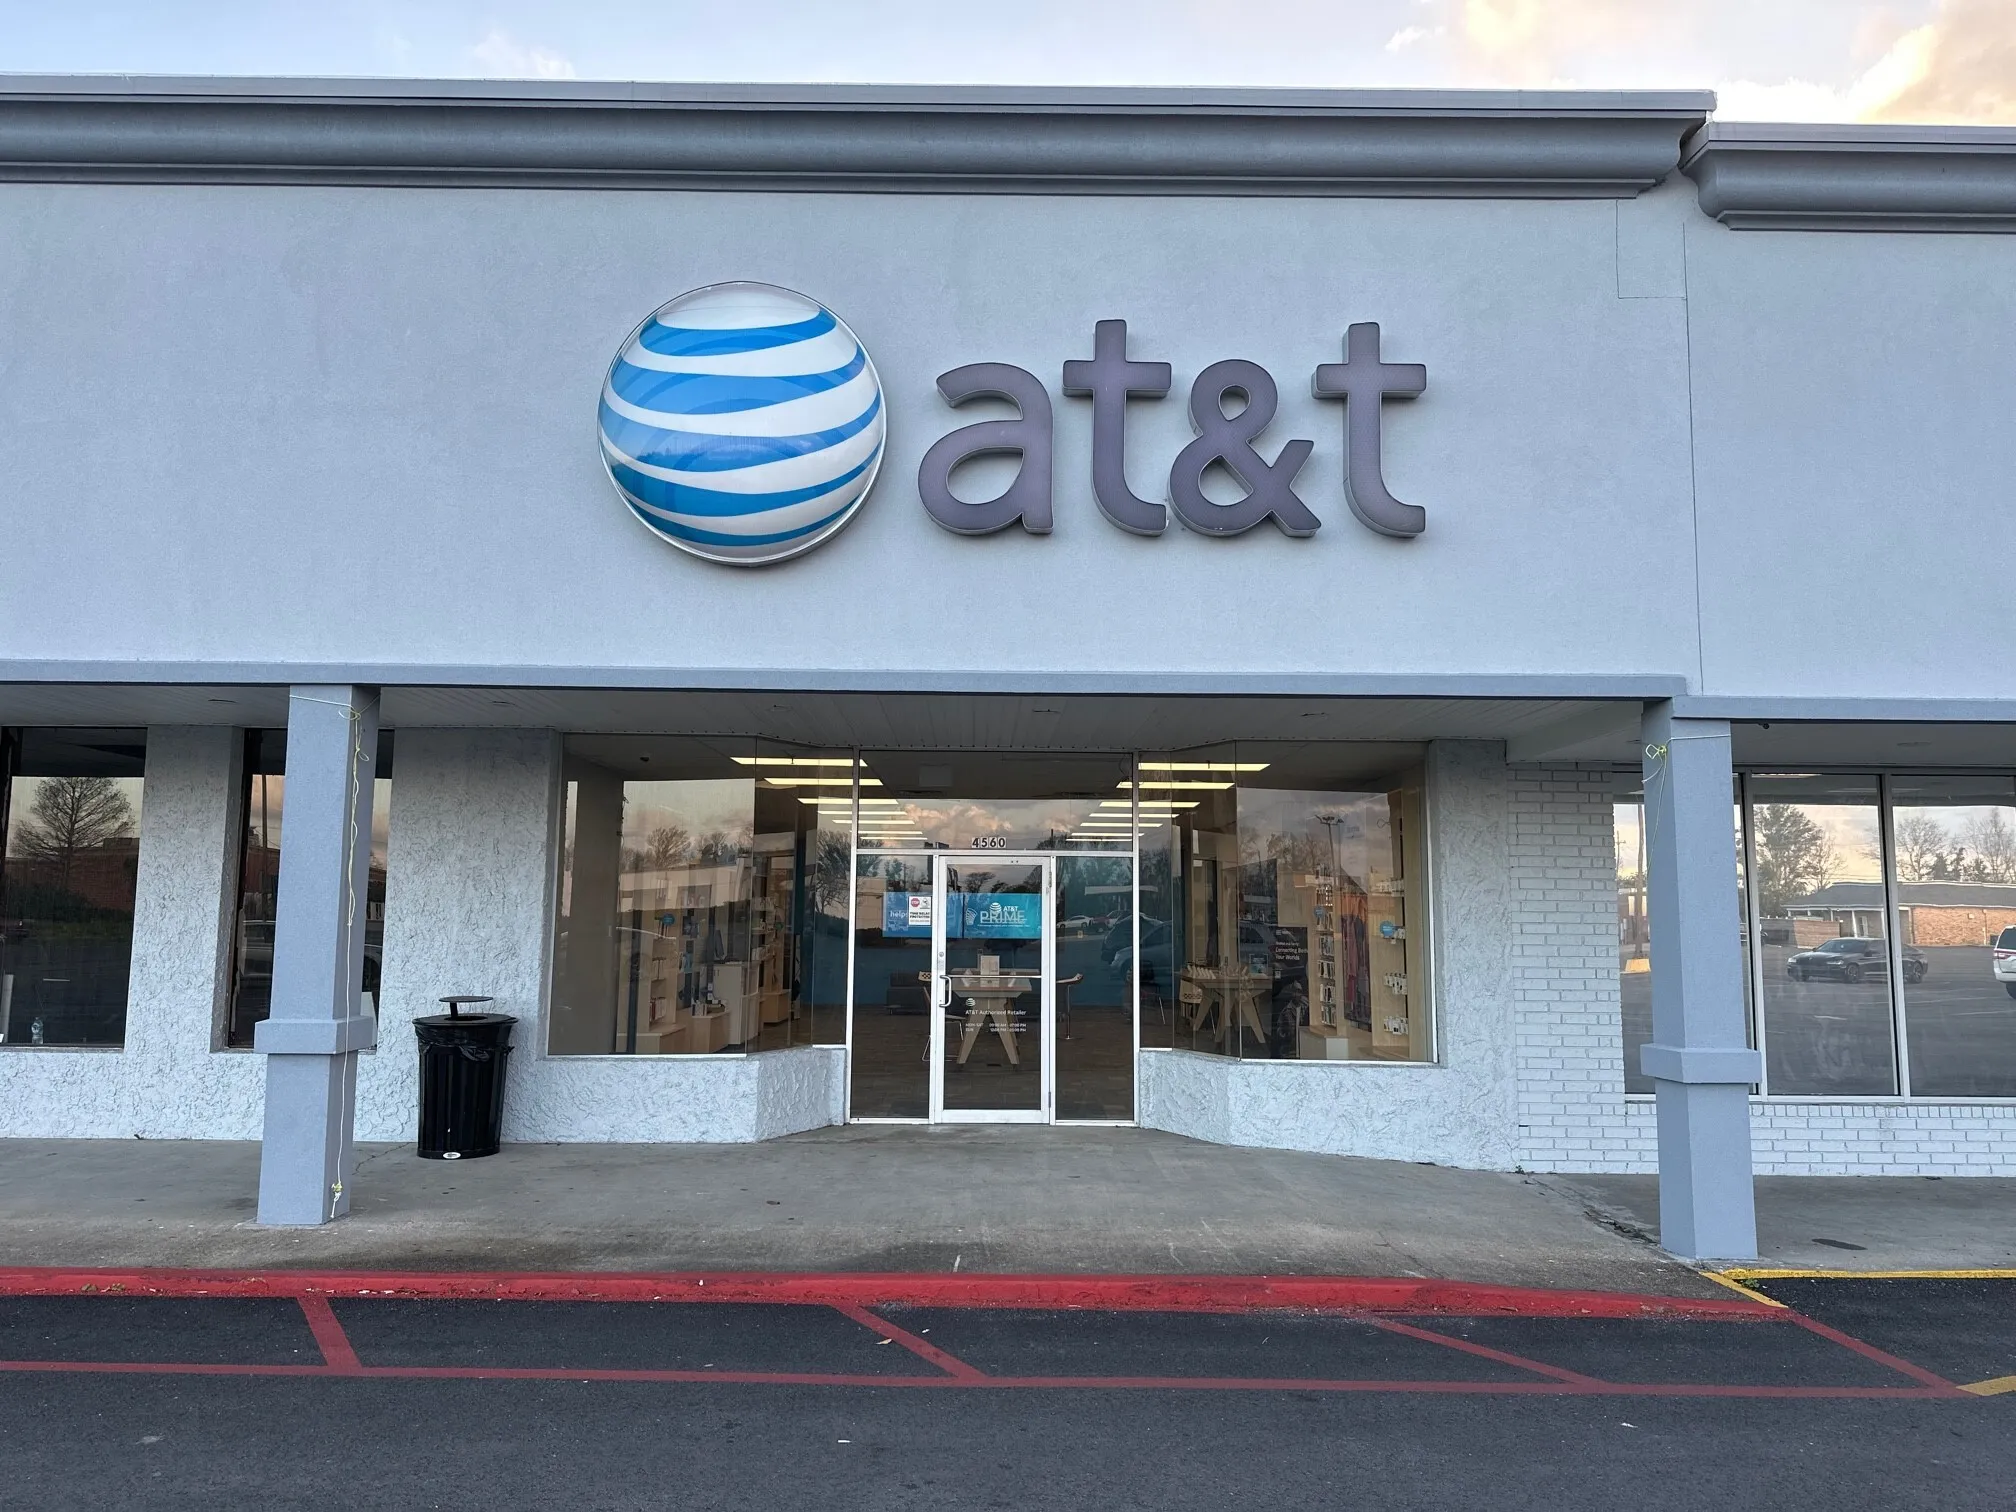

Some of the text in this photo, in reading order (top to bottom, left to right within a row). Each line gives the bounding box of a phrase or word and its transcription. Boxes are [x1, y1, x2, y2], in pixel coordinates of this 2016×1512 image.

[917, 319, 1427, 539] at&t
[972, 837, 1006, 848] 4560
[980, 910, 1025, 923] PRIME
